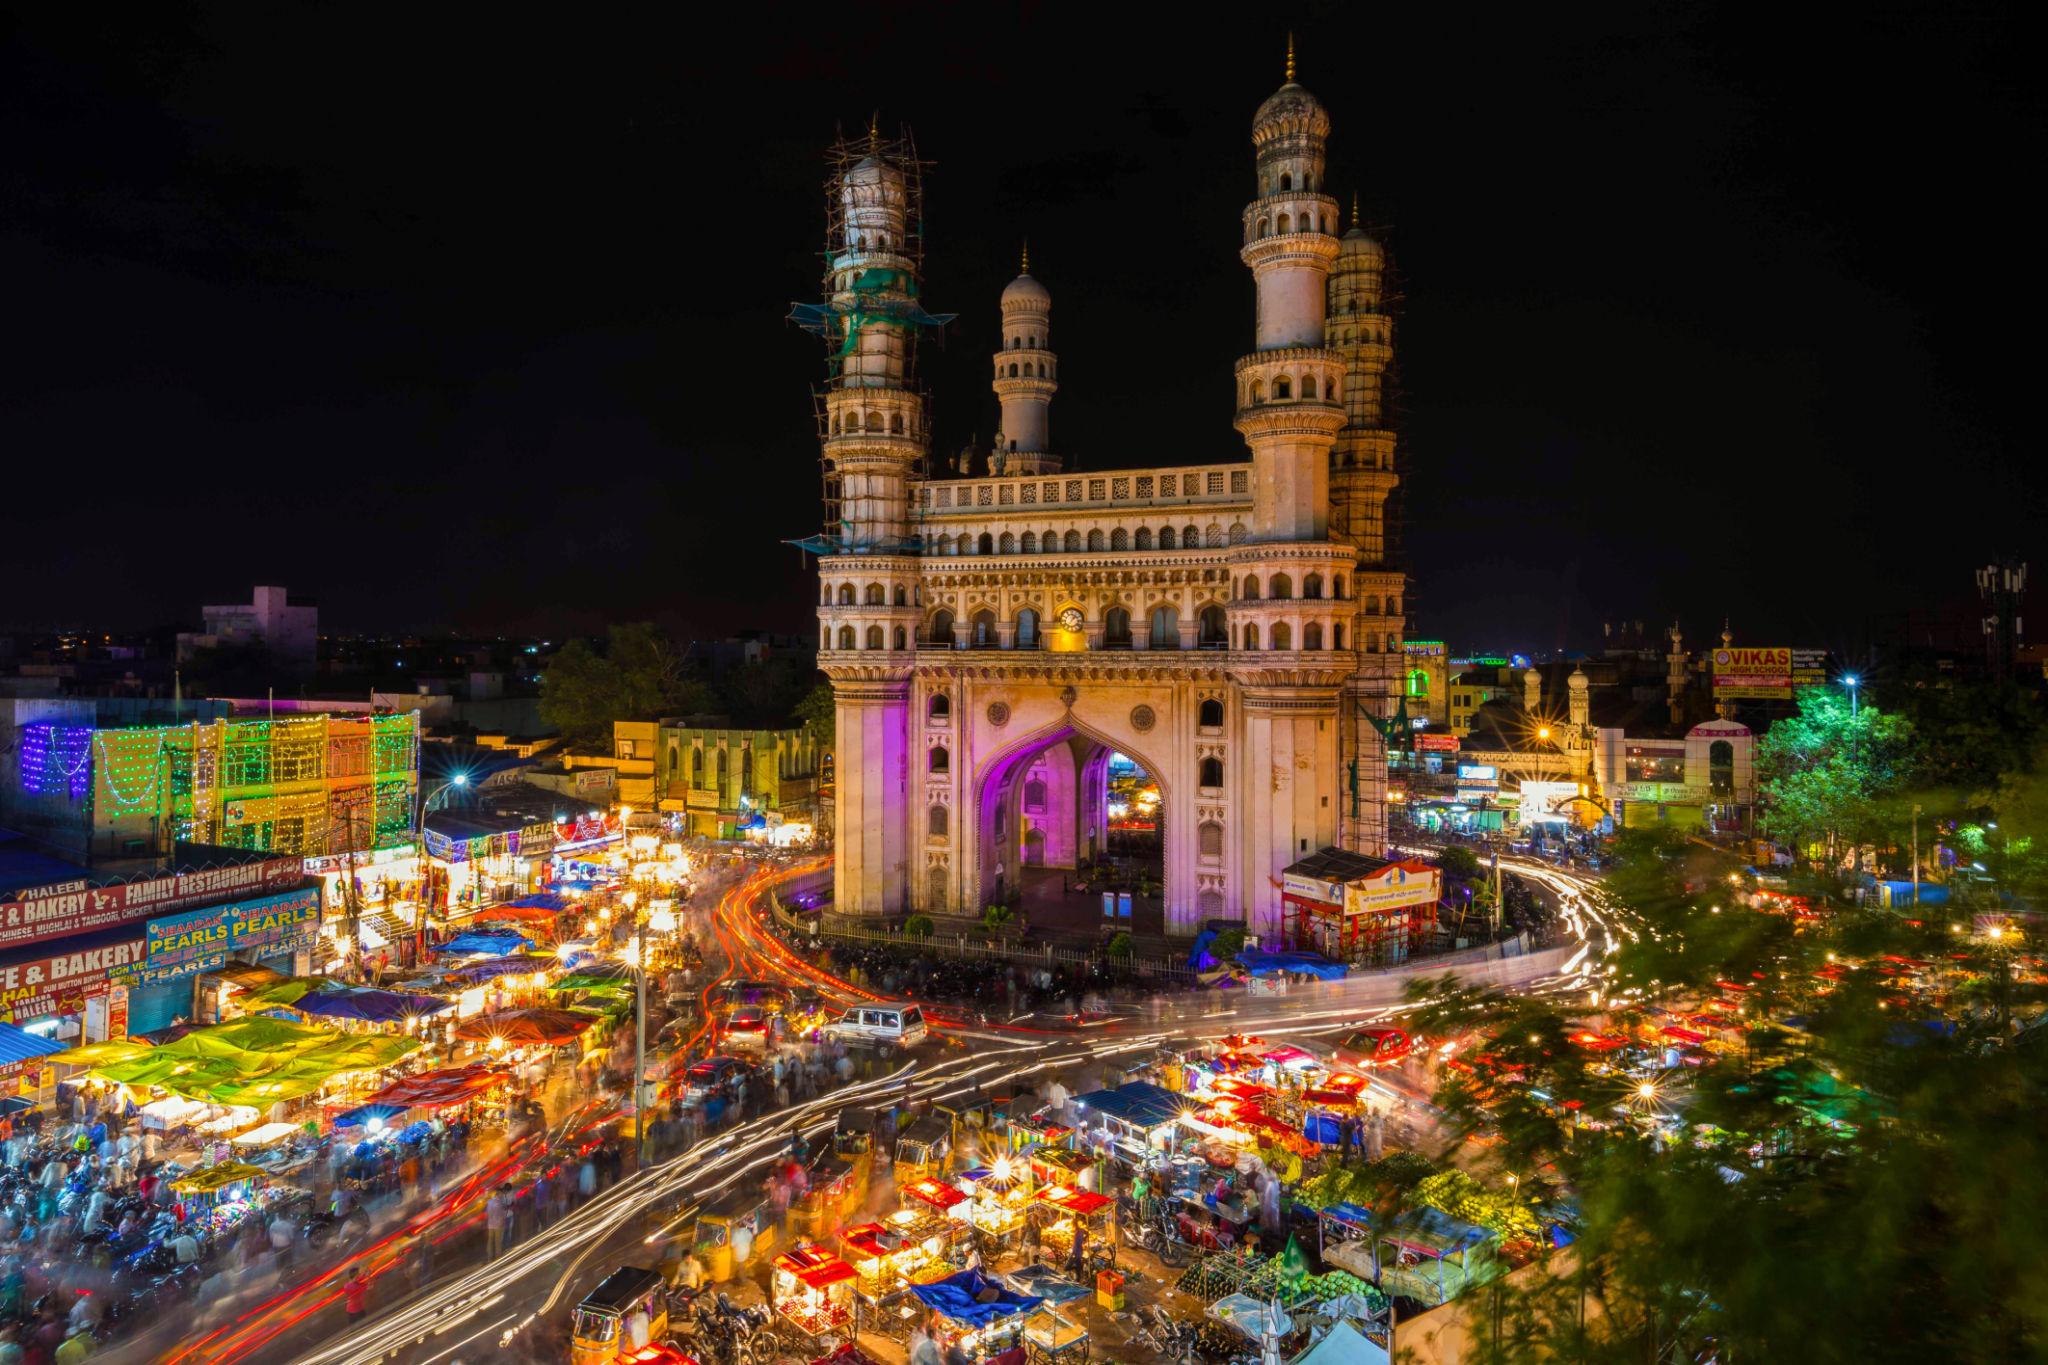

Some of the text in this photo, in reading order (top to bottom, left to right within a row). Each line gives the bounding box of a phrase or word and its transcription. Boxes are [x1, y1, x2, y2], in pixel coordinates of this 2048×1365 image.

[1730, 666, 1789, 674] HIGH SCHOOL
[1731, 650, 1789, 666] VIKAS
[28, 880, 86, 900] HALEEM
[125, 878, 175, 905] FAMILY
[178, 864, 264, 896] RESTAURANT
[7, 907, 20, 926] &
[24, 892, 88, 924] BAKERY
[158, 917, 222, 938] SHAADAN
[239, 899, 310, 921] SHAADAN
[37, 919, 72, 935] MUGHLAI
[73, 918, 80, 929] &
[151, 925, 228, 954] PEARLS
[233, 906, 318, 937] PEARLS
[260, 932, 315, 956] PEARLS
[26, 966, 45, 985] &
[51, 941, 144, 980] BAKERY
[144, 954, 222, 981] PEARLS
[43, 984, 57, 994] DUM
[58, 978, 82, 991] MUTTON
[14, 999, 57, 1020] HALEEM
